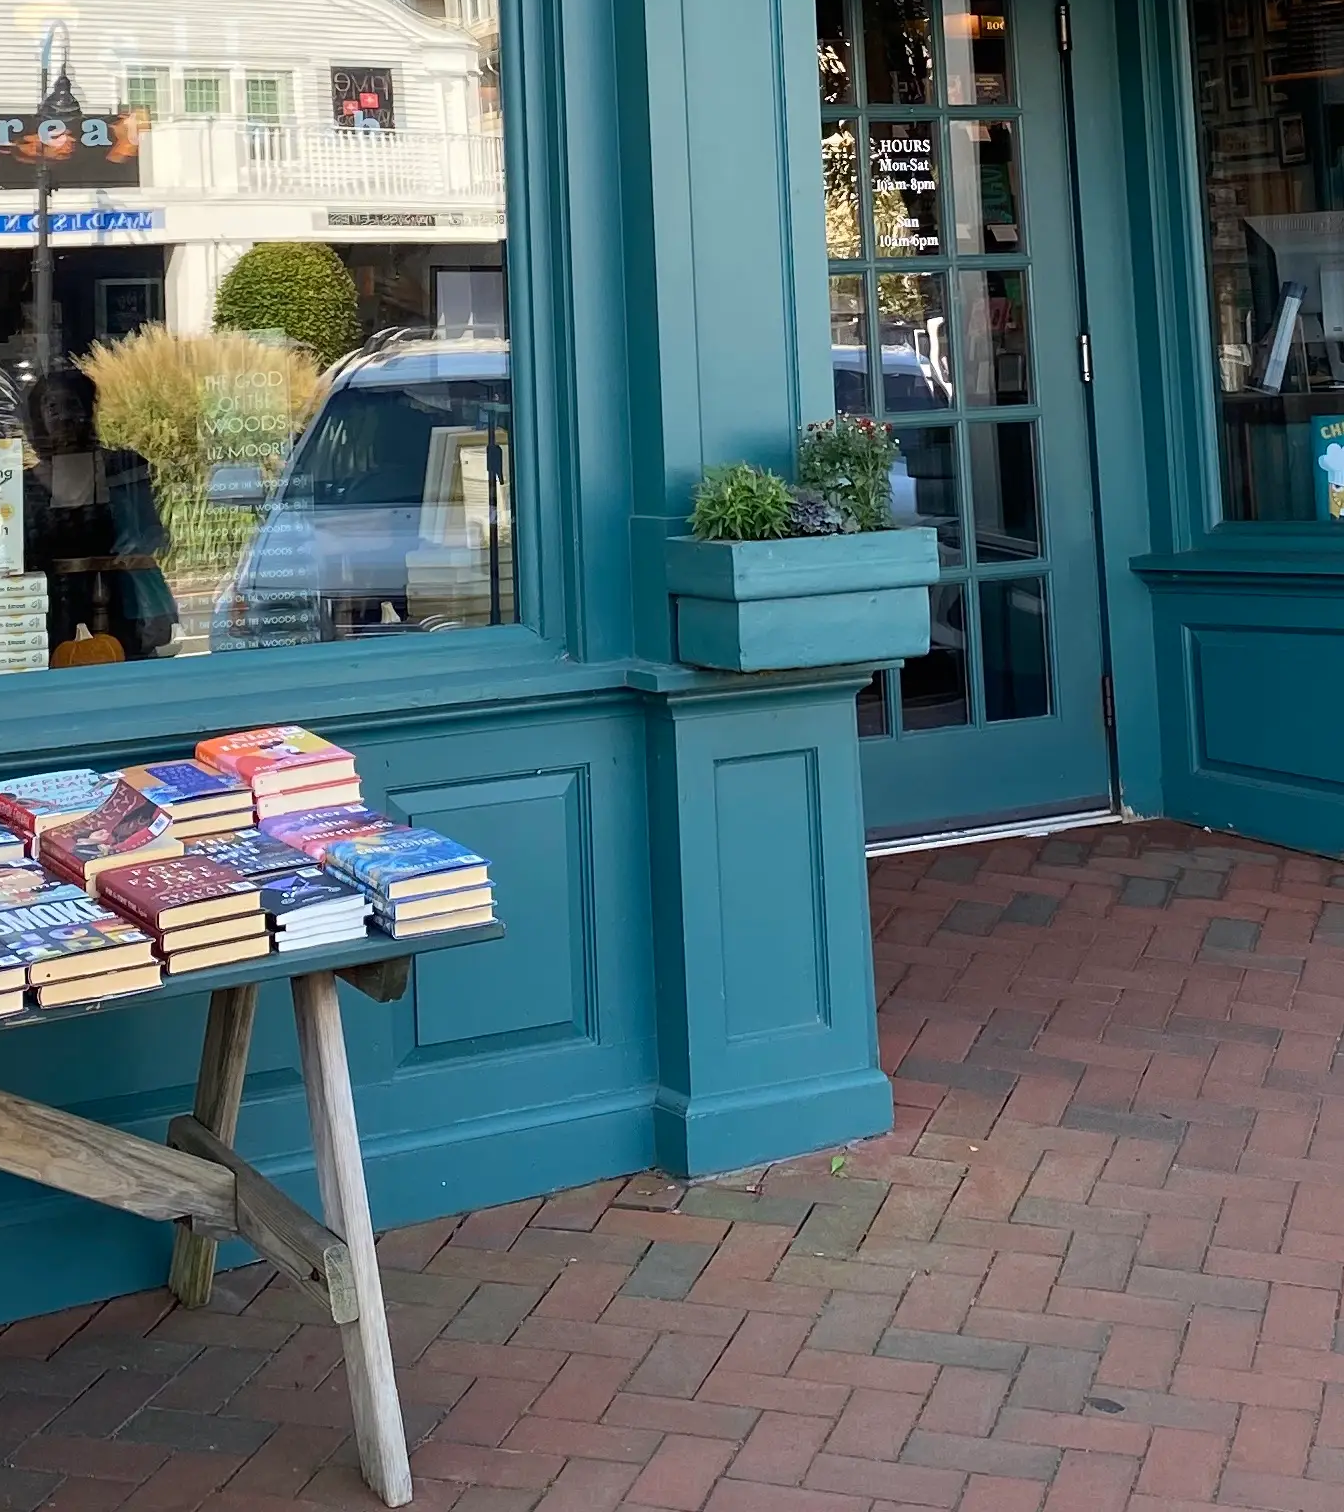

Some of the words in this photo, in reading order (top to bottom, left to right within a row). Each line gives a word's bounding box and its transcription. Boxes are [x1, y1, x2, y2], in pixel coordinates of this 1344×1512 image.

[880, 140, 931, 152] HOURS
[879, 158, 929, 171] Mon-Sat
[876, 178, 936, 194] 10am-8pm
[897, 218, 919, 228] Sun
[880, 234, 939, 250] 10am-6pm
[235, 371, 283, 389] GOD
[204, 414, 287, 435] WOODS
[207, 446, 224, 460] LIZ
[228, 441, 285, 459] MOORE
